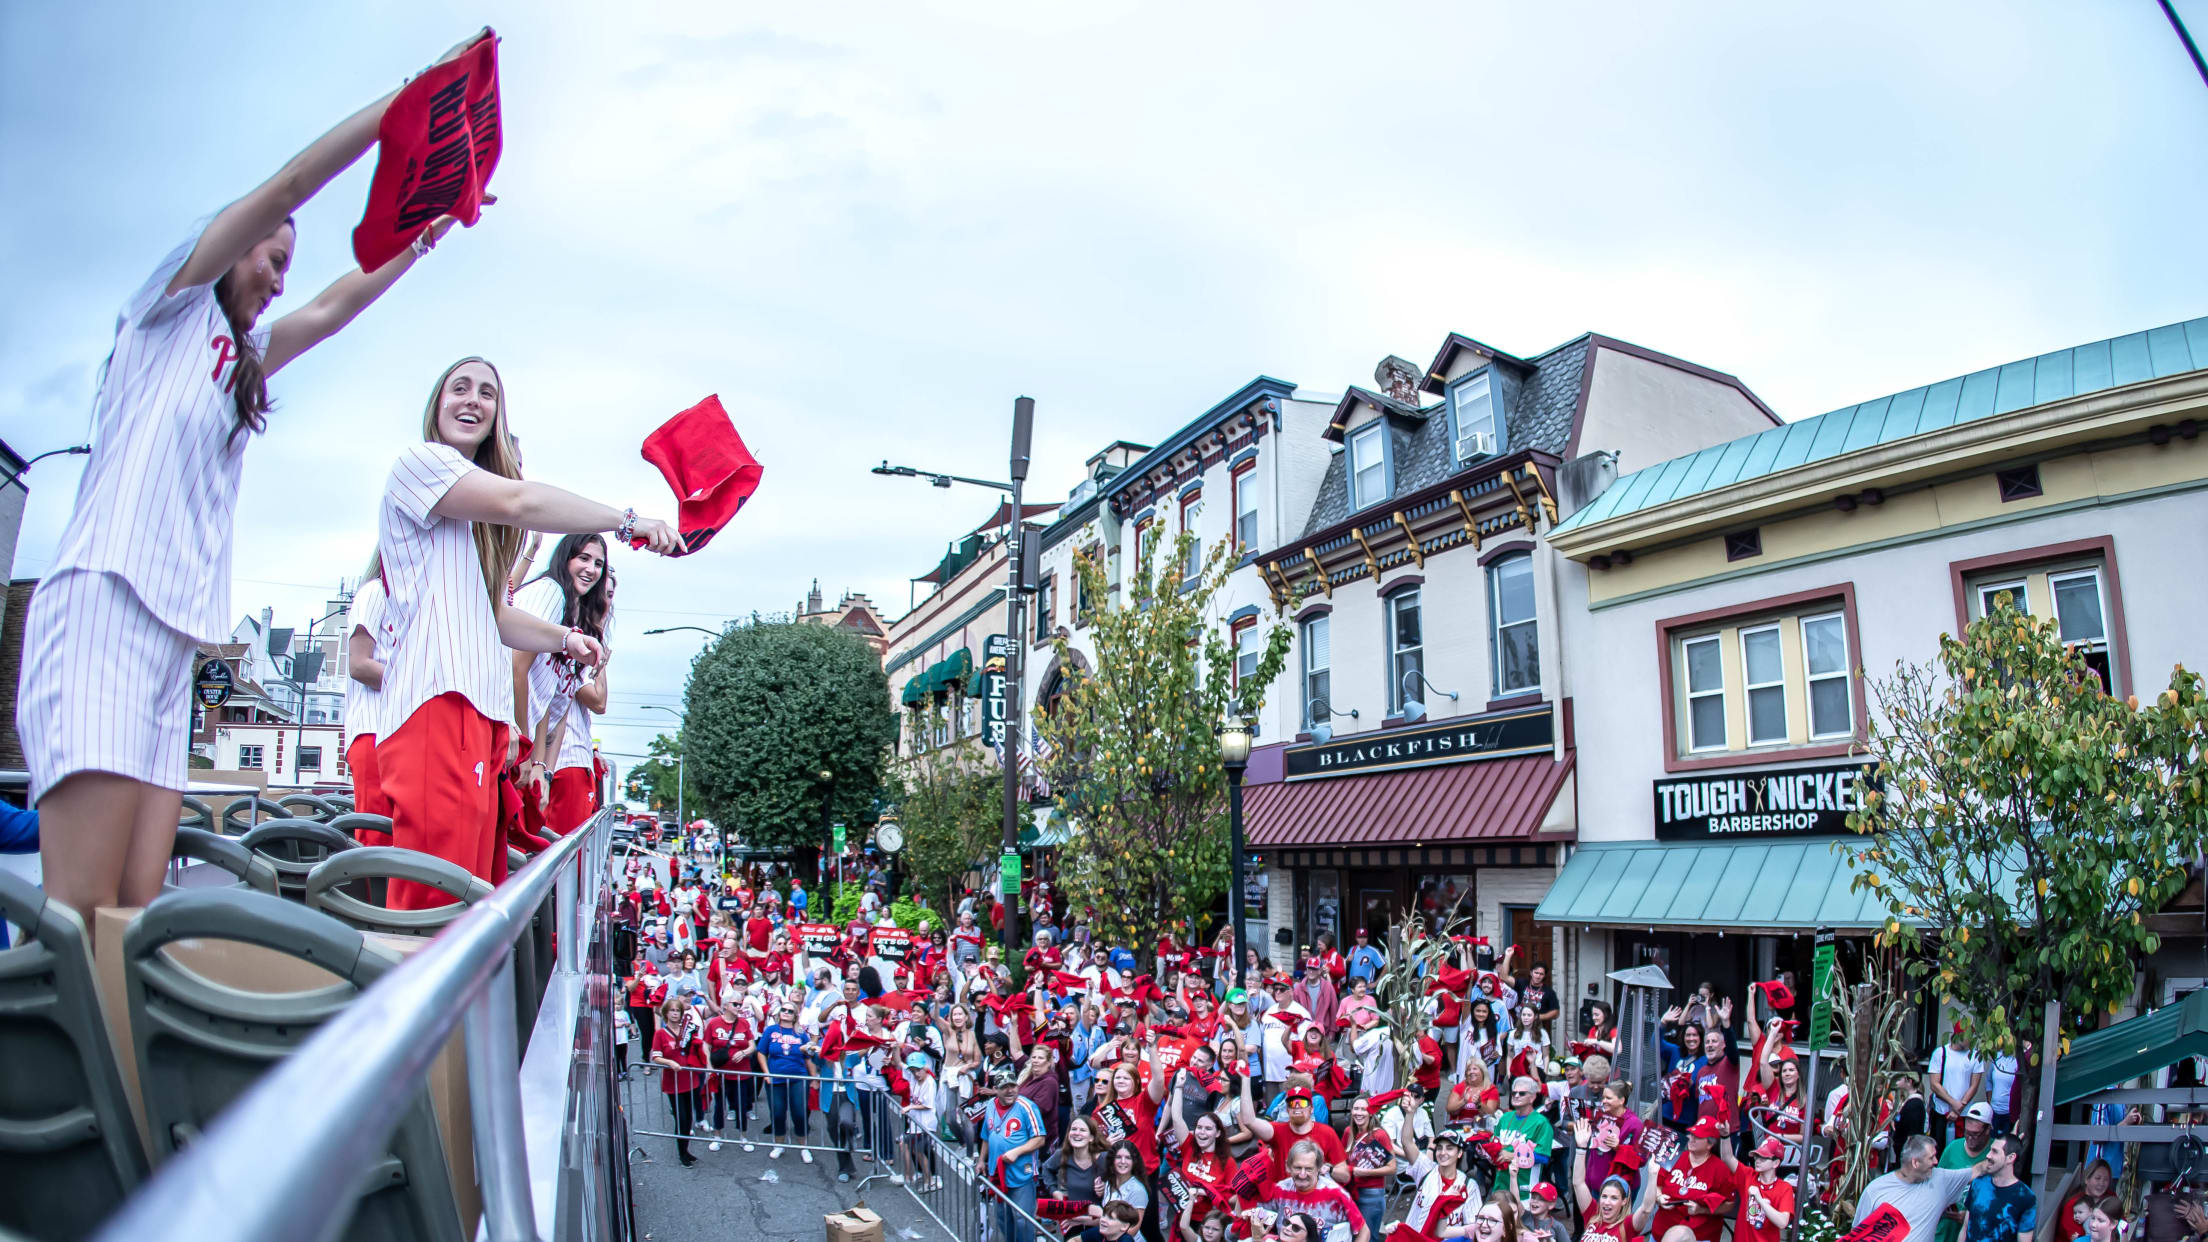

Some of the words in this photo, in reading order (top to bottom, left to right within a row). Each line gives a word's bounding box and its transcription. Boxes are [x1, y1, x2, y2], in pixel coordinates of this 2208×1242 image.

[429, 72, 469, 144] RED
[398, 133, 470, 234] OCTOBER
[988, 675, 1007, 743] PUB
[1319, 732, 1478, 766] BLACKFISH
[1657, 780, 1747, 823] TOUGH
[1768, 771, 1867, 811] NICKEL
[1708, 812, 1818, 833] BARBERSHOP
[873, 937, 897, 945] LET'S
[1360, 956, 1370, 966] P
[1158, 1053, 1180, 1067] AST
[1004, 1118, 1021, 1138] P
